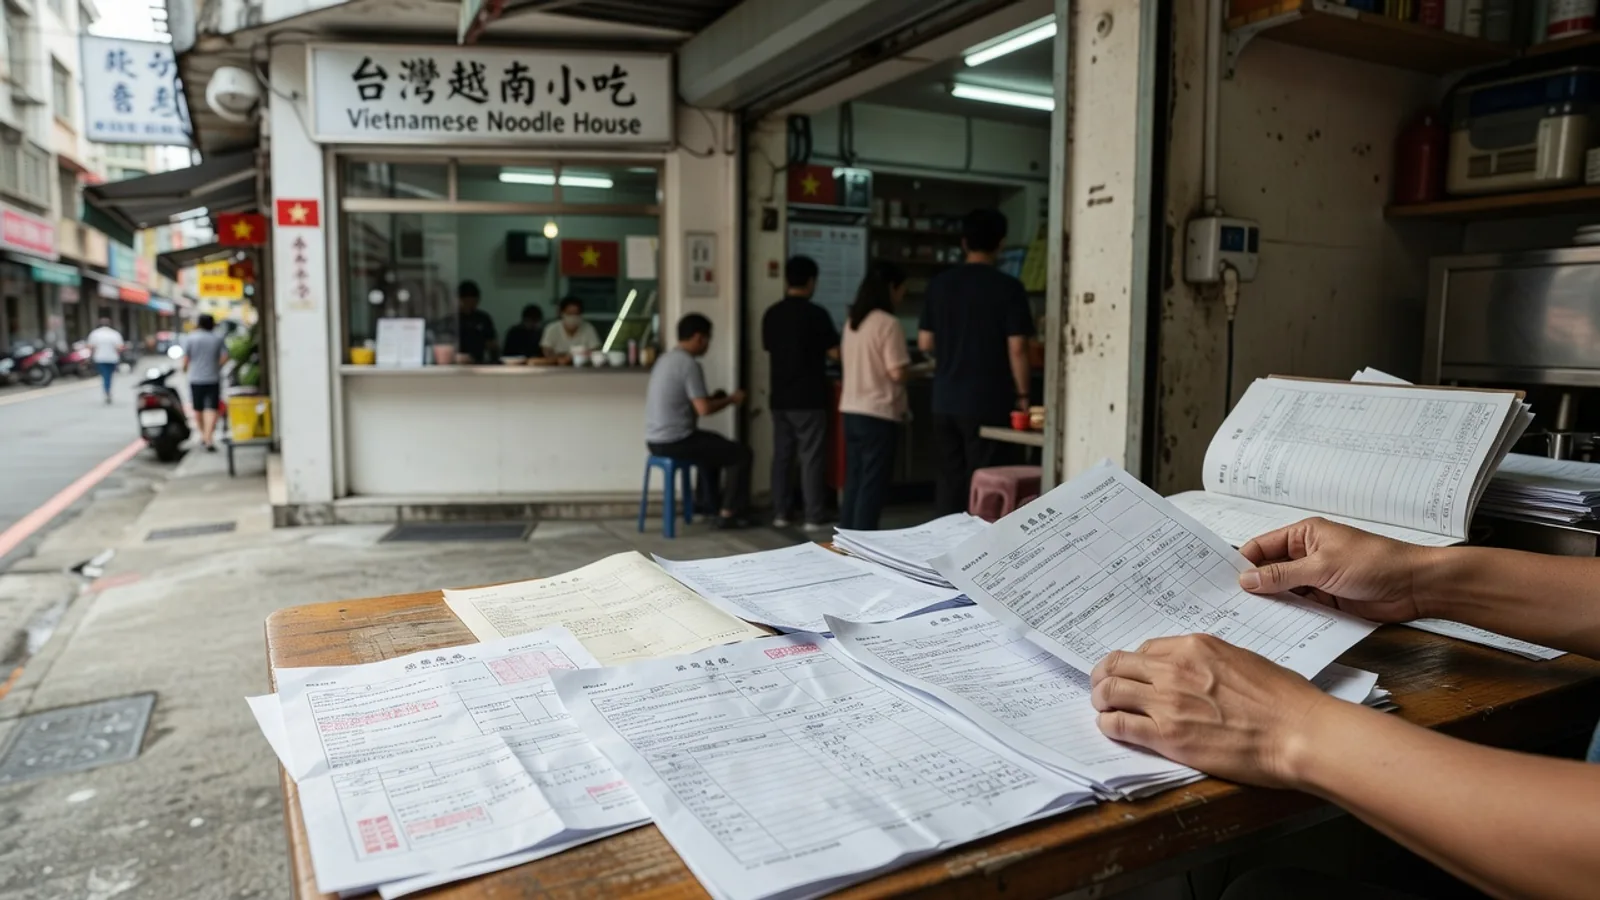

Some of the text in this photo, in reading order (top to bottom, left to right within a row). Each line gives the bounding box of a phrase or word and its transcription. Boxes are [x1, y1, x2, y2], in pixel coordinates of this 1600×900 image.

[352, 56, 637, 107] 台灣越南小吃
[347, 107, 642, 135] Vietnamese Noodle House
